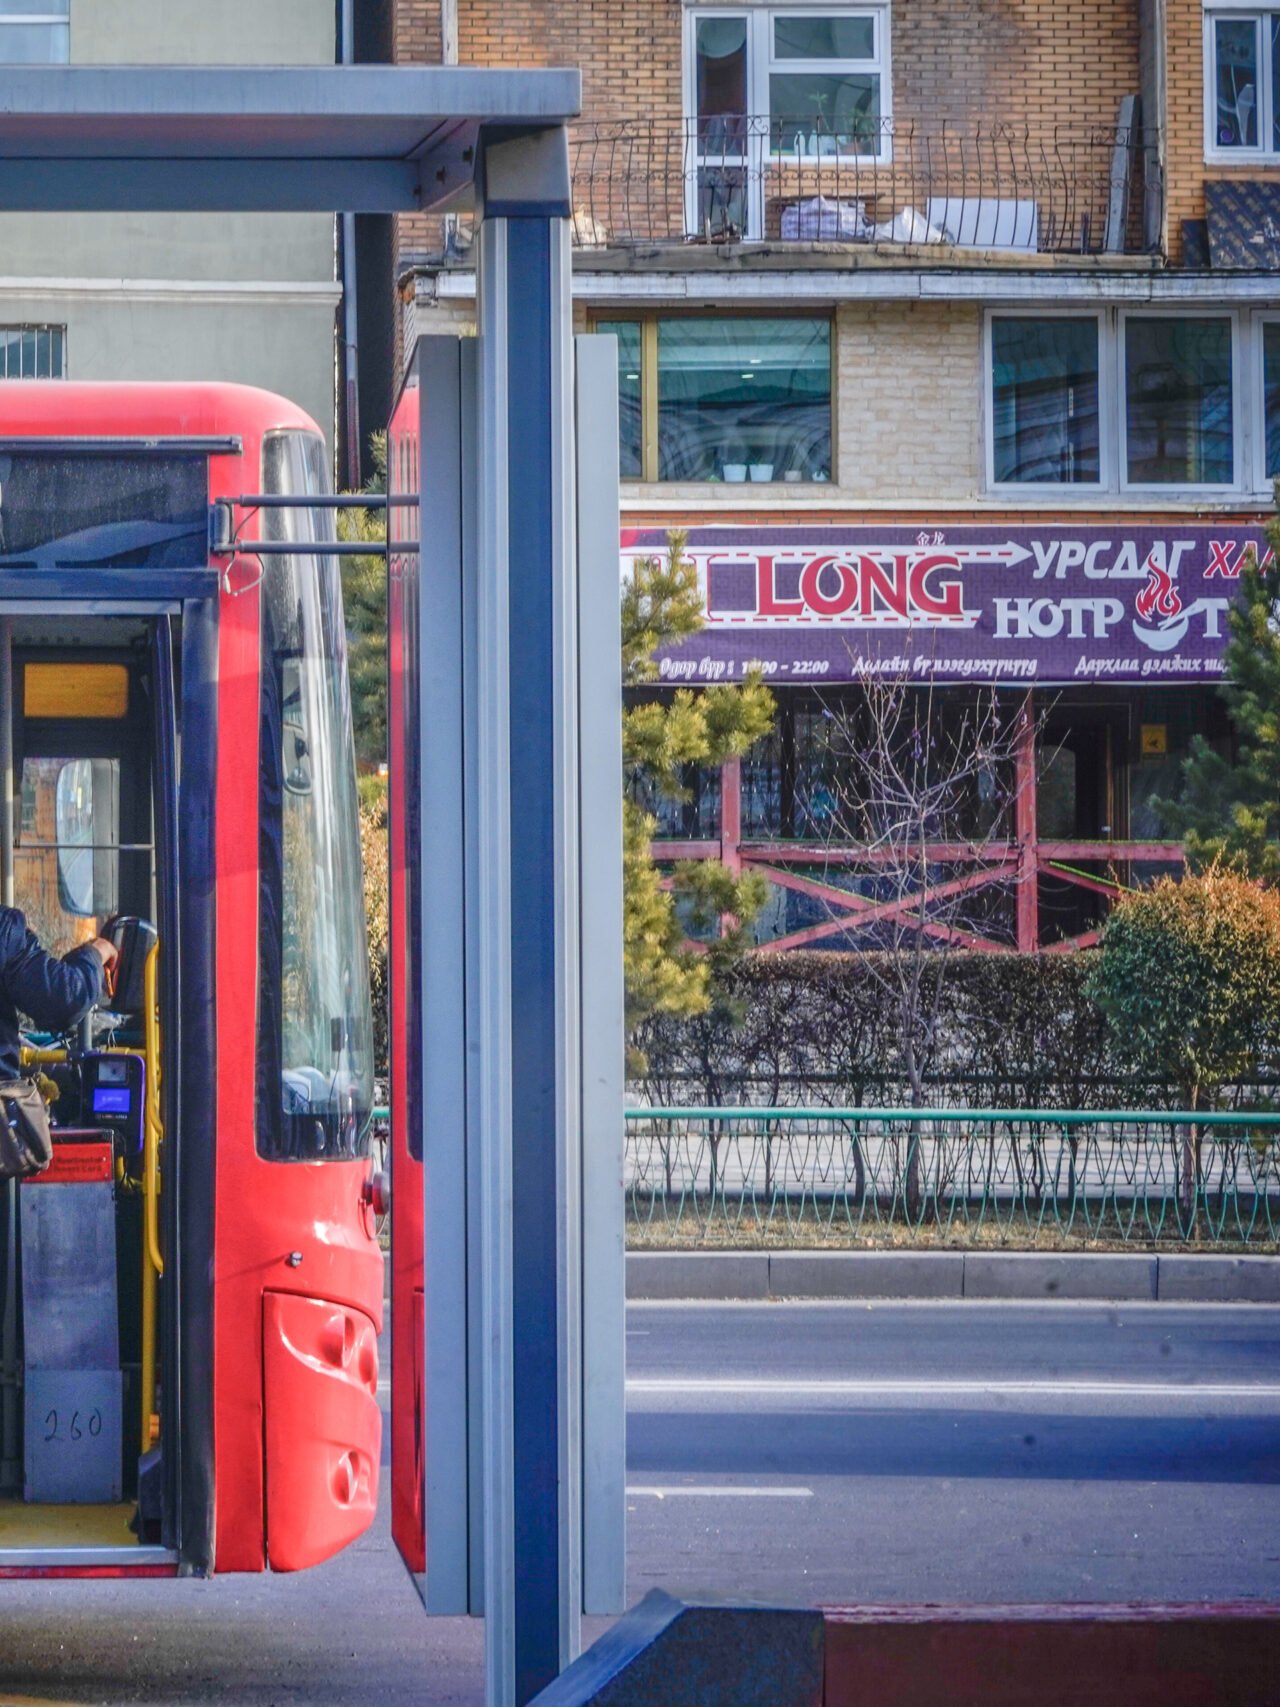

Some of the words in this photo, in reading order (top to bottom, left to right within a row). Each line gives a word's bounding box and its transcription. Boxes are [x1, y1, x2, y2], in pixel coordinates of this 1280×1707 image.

[756, 553, 964, 617] LONG
[791, 660, 830, 675] 22:00
[44, 1409, 102, 1443] 260
